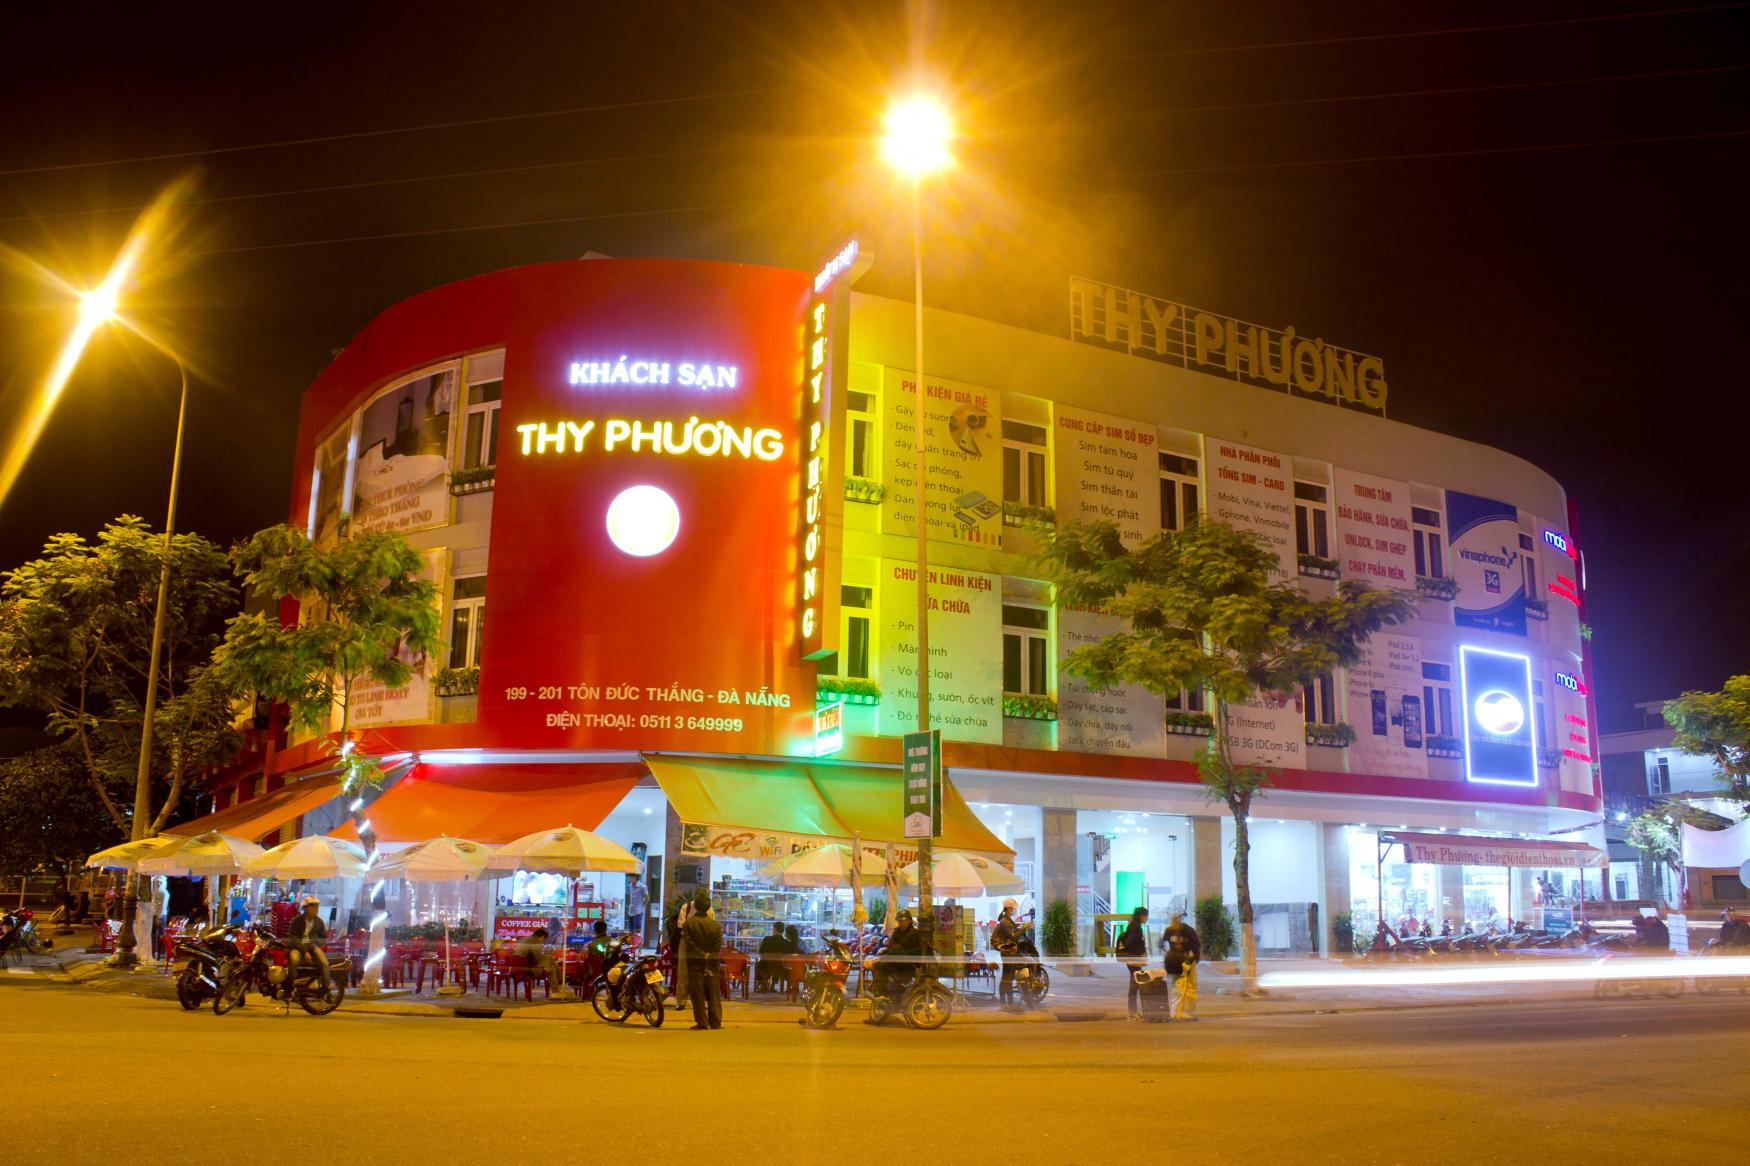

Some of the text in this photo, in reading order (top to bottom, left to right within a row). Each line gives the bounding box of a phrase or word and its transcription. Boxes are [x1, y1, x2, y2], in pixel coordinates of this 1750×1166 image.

[811, 303, 828, 404] THY
[1070, 282, 1389, 409] THY PHƯƠNG
[569, 355, 738, 390] KHÁCH SẠN
[1059, 416, 1084, 432] CUNG
[1106, 426, 1123, 439] SIM
[516, 415, 785, 461] THY PHƯƠNG
[1079, 440, 1138, 461] Sim tam hoa
[1084, 460, 1101, 473] Sim
[1081, 480, 1098, 493] Sim
[1241, 473, 1257, 485] SIM
[1263, 478, 1285, 491] CARD
[1354, 484, 1377, 500] TRUNG
[1081, 501, 1098, 514] Sim
[802, 421, 823, 638] PHƯƠNG
[1459, 549, 1507, 567] vinaphone
[940, 572, 965, 587] LINH
[967, 575, 992, 592] KIỆN
[1485, 571, 1499, 587] 3G
[941, 598, 971, 614] CHỮA
[898, 620, 914, 632] Pin
[504, 687, 527, 700] 199
[538, 687, 562, 700] 201
[567, 682, 600, 700] TÔN
[605, 683, 640, 700] ĐỨC
[646, 681, 704, 703] THẮNG
[717, 688, 740, 705] ĐÀ
[546, 711, 743, 732] ĐIỆN THOẠI: 0511 3 649999
[1236, 716, 1276, 732] (Internet)
[1241, 738, 1254, 749] 3G
[1285, 741, 1299, 753] 3G)
[1416, 846, 1435, 861] Thy
[501, 919, 531, 928] COFFEE
